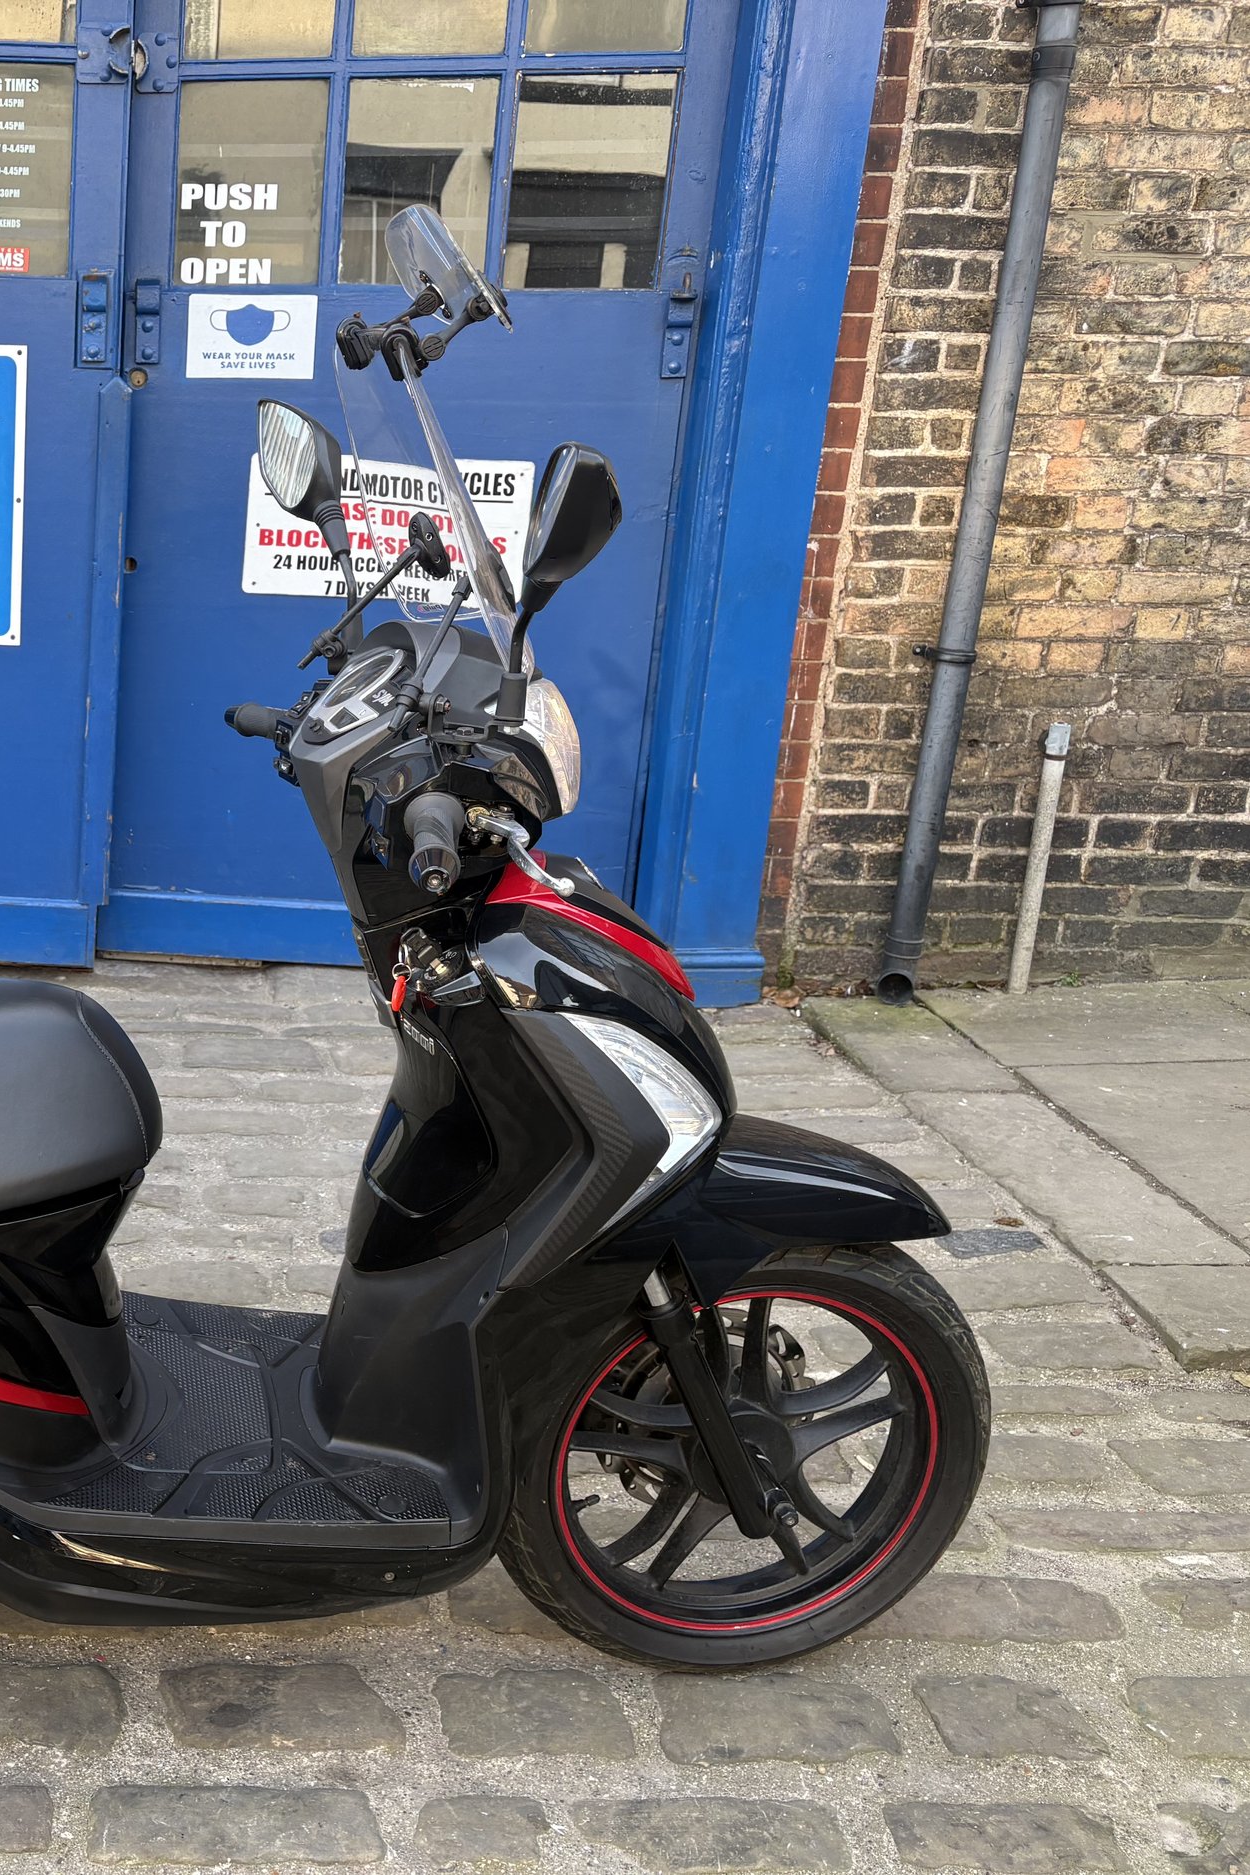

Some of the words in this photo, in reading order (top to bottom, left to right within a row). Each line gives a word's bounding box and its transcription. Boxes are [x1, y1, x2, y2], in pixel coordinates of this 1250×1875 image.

[5, 78, 39, 92] TIMES
[2, 143, 36, 154] 9-4.45PM
[180, 183, 278, 211] PUSH
[200, 220, 246, 248] TO
[180, 257, 272, 285] OPEN
[202, 351, 231, 360] WEAR
[235, 352, 262, 360] YOUR
[266, 352, 295, 361] MASK
[220, 361, 246, 369] SAVE
[249, 361, 276, 370] LIVES
[362, 473, 424, 502] MOTOR
[381, 508, 410, 528] DO
[432, 514, 453, 534] OT
[273, 554, 292, 570] 24
[296, 555, 339, 571] HOUR
[324, 580, 332, 595] 7
[336, 581, 375, 597] DYS
